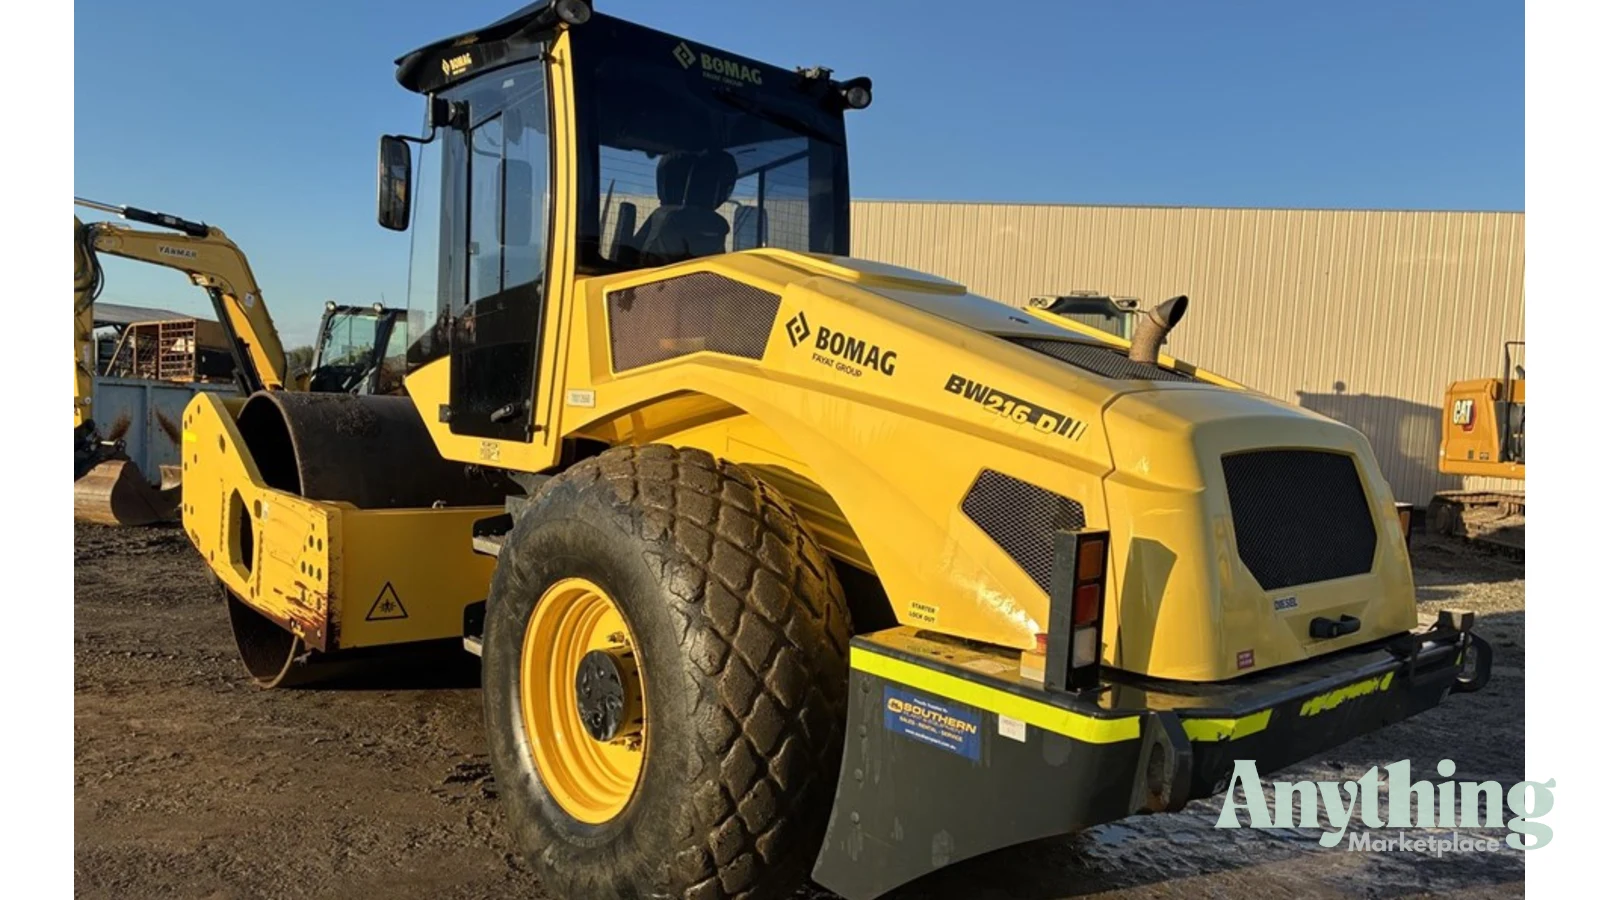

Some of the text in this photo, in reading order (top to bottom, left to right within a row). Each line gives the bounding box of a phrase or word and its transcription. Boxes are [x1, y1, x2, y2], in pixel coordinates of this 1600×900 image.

[701, 52, 763, 85] BOMAG
[158, 245, 198, 258] YANMAR
[815, 325, 897, 376] BOMAG
[812, 353, 862, 377] FAYAT GROUP
[1453, 399, 1474, 425] CAT
[908, 611, 923, 620] LOCK
[911, 601, 935, 613] STARTER
[903, 702, 977, 734] SOUTHERN
